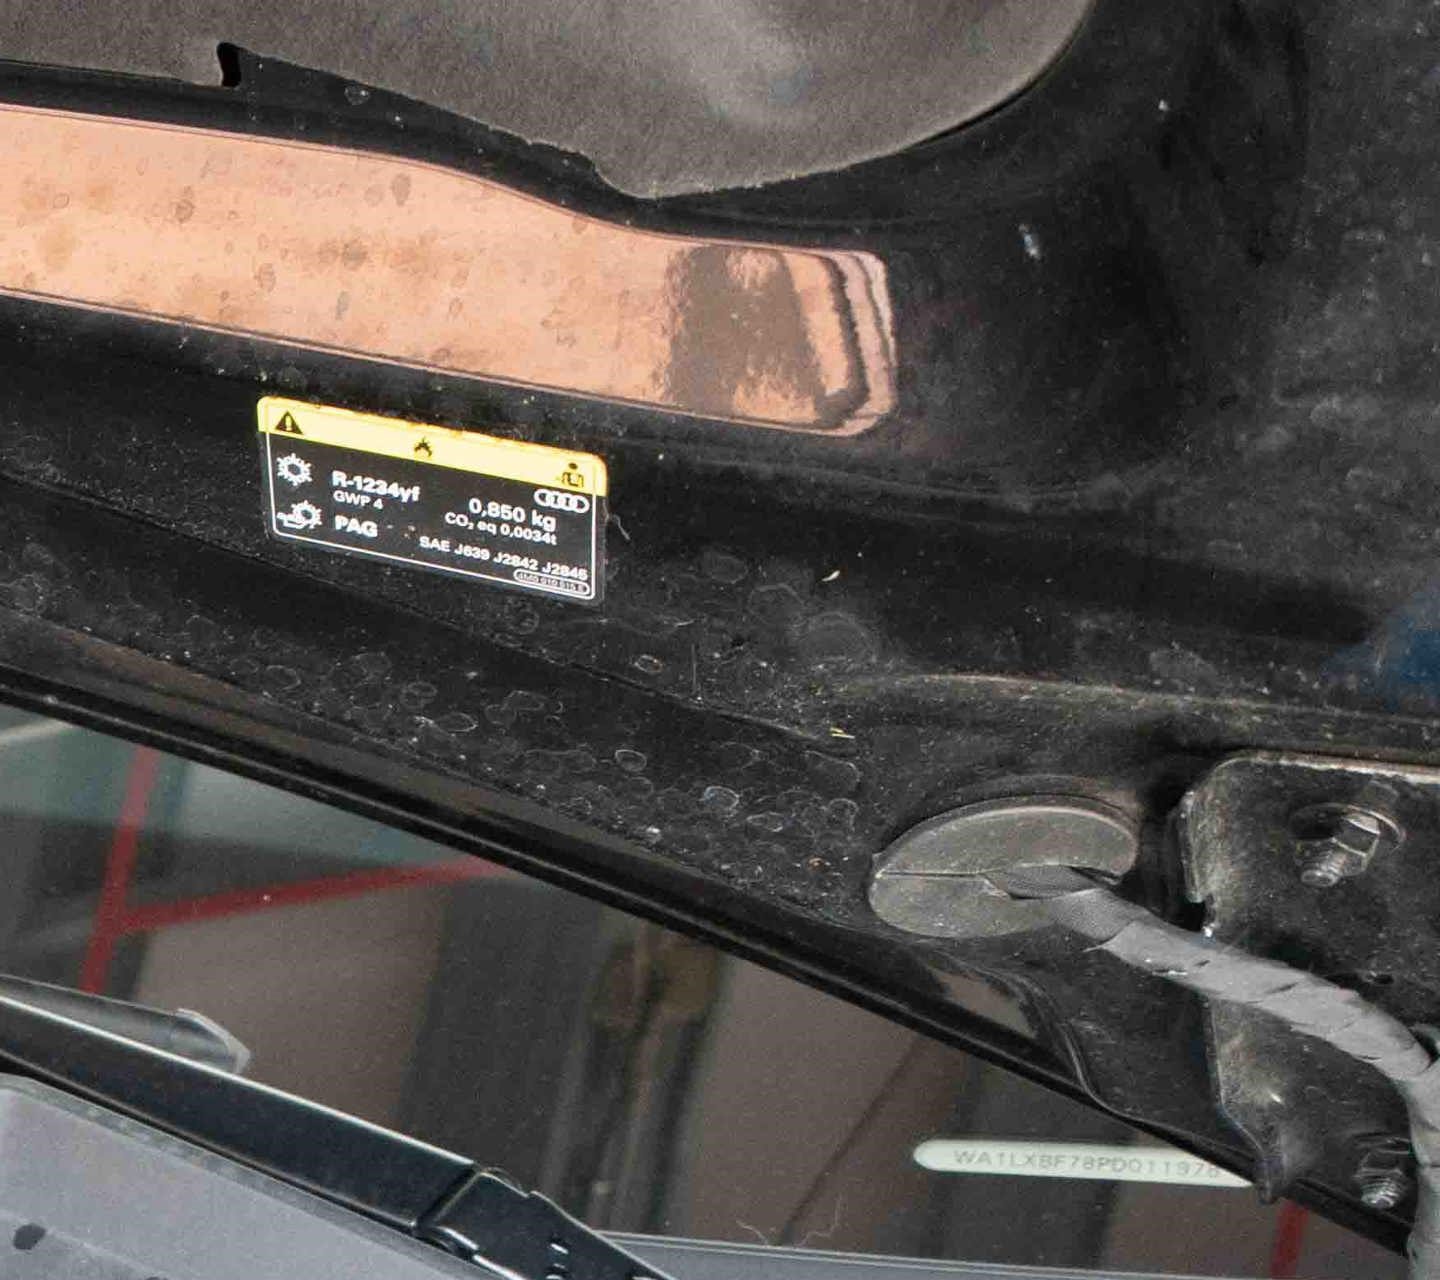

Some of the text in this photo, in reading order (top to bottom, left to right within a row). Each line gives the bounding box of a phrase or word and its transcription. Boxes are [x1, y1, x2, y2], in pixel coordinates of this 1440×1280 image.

[331, 469, 419, 504] R-1234yf
[333, 489, 382, 510] GWP 4
[335, 514, 377, 538] PAG
[469, 496, 556, 533] 0,850 kg
[478, 520, 496, 536] eq
[500, 522, 556, 546] 0,0034t
[419, 535, 449, 552] SAE
[494, 551, 537, 571] J2842
